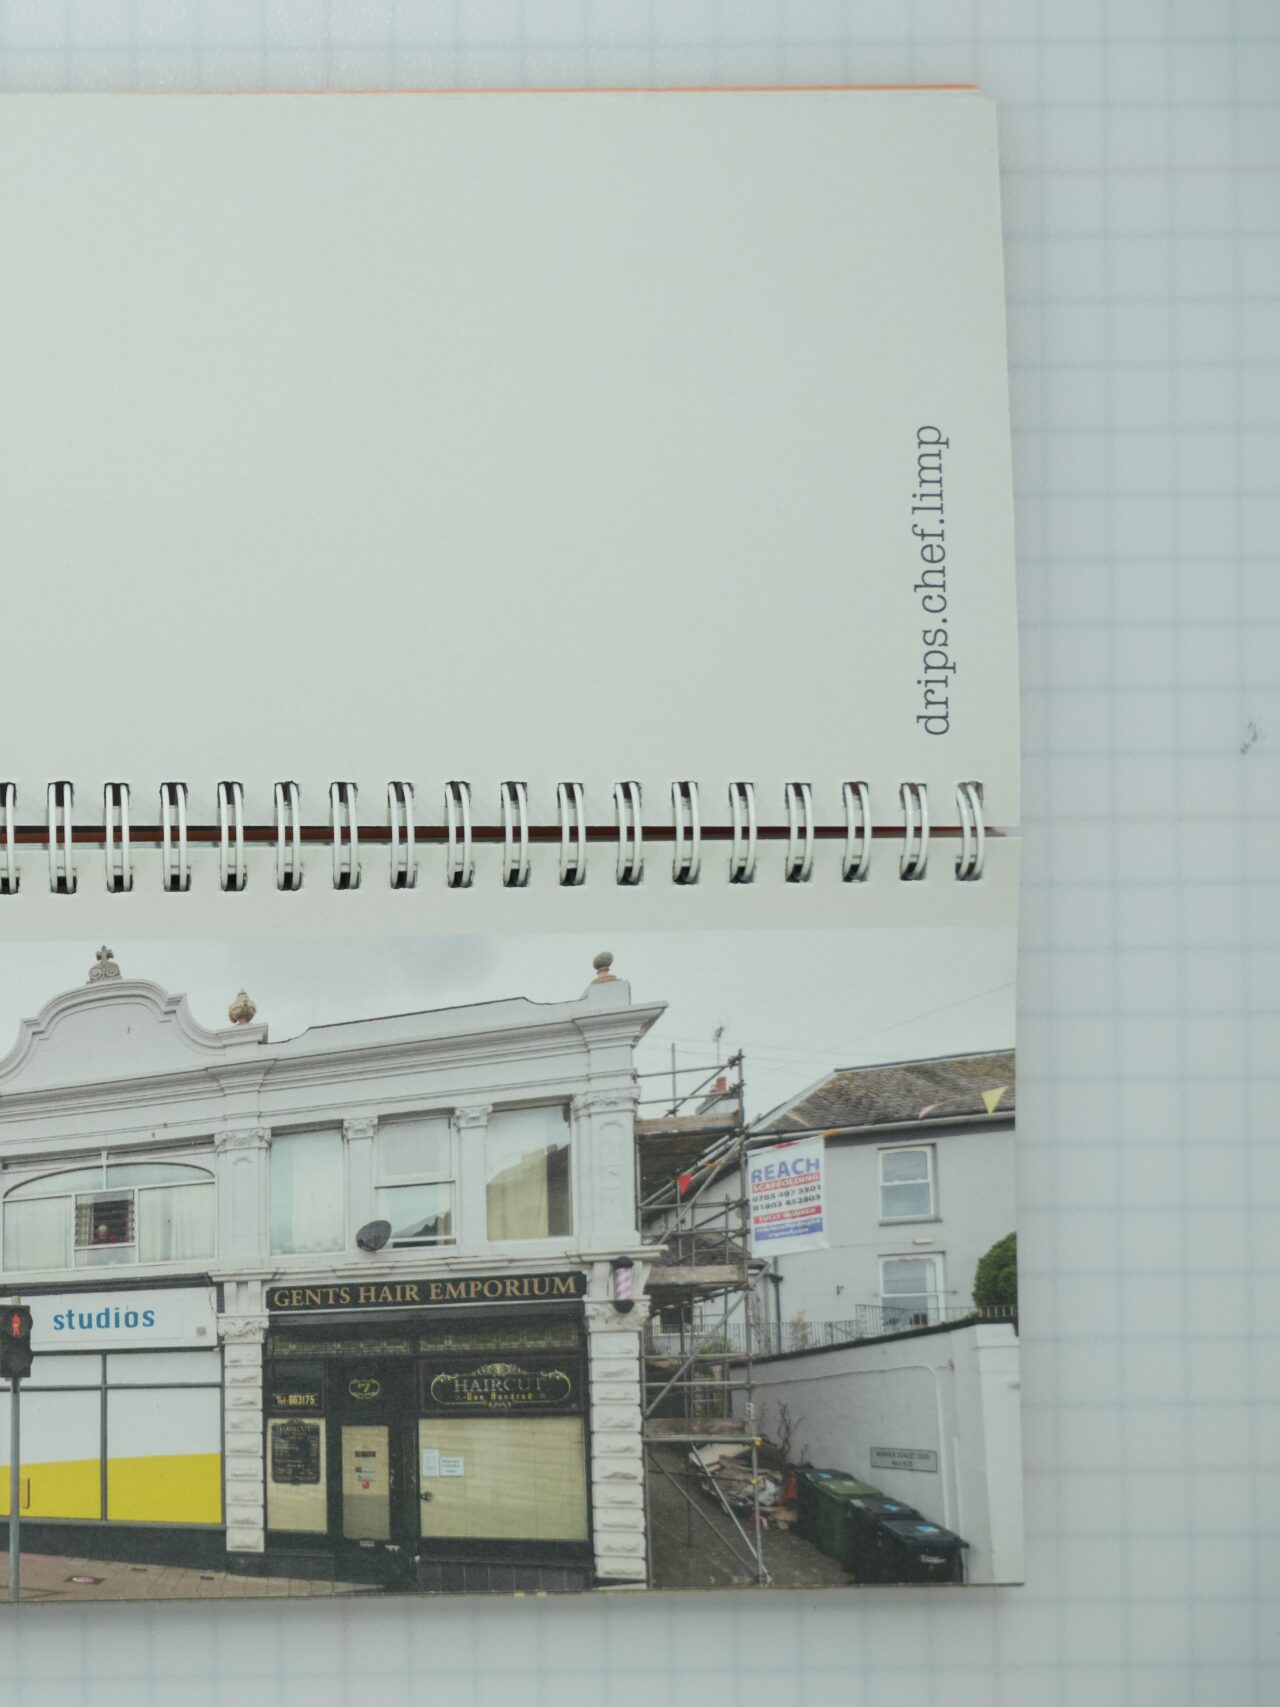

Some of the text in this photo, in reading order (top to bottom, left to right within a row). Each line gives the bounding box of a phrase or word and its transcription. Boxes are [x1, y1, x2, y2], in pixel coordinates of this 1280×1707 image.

[912, 425, 957, 736] drips.chef.limp
[751, 1157, 820, 1184] REACH
[752, 1173, 820, 1193] SCAFFOLDING
[274, 1275, 577, 1308] GENTS HAIR EMPORIUM
[53, 1307, 156, 1331] studios
[454, 1377, 545, 1393] HAIRCUT
[490, 1389, 534, 1401] Hundred
